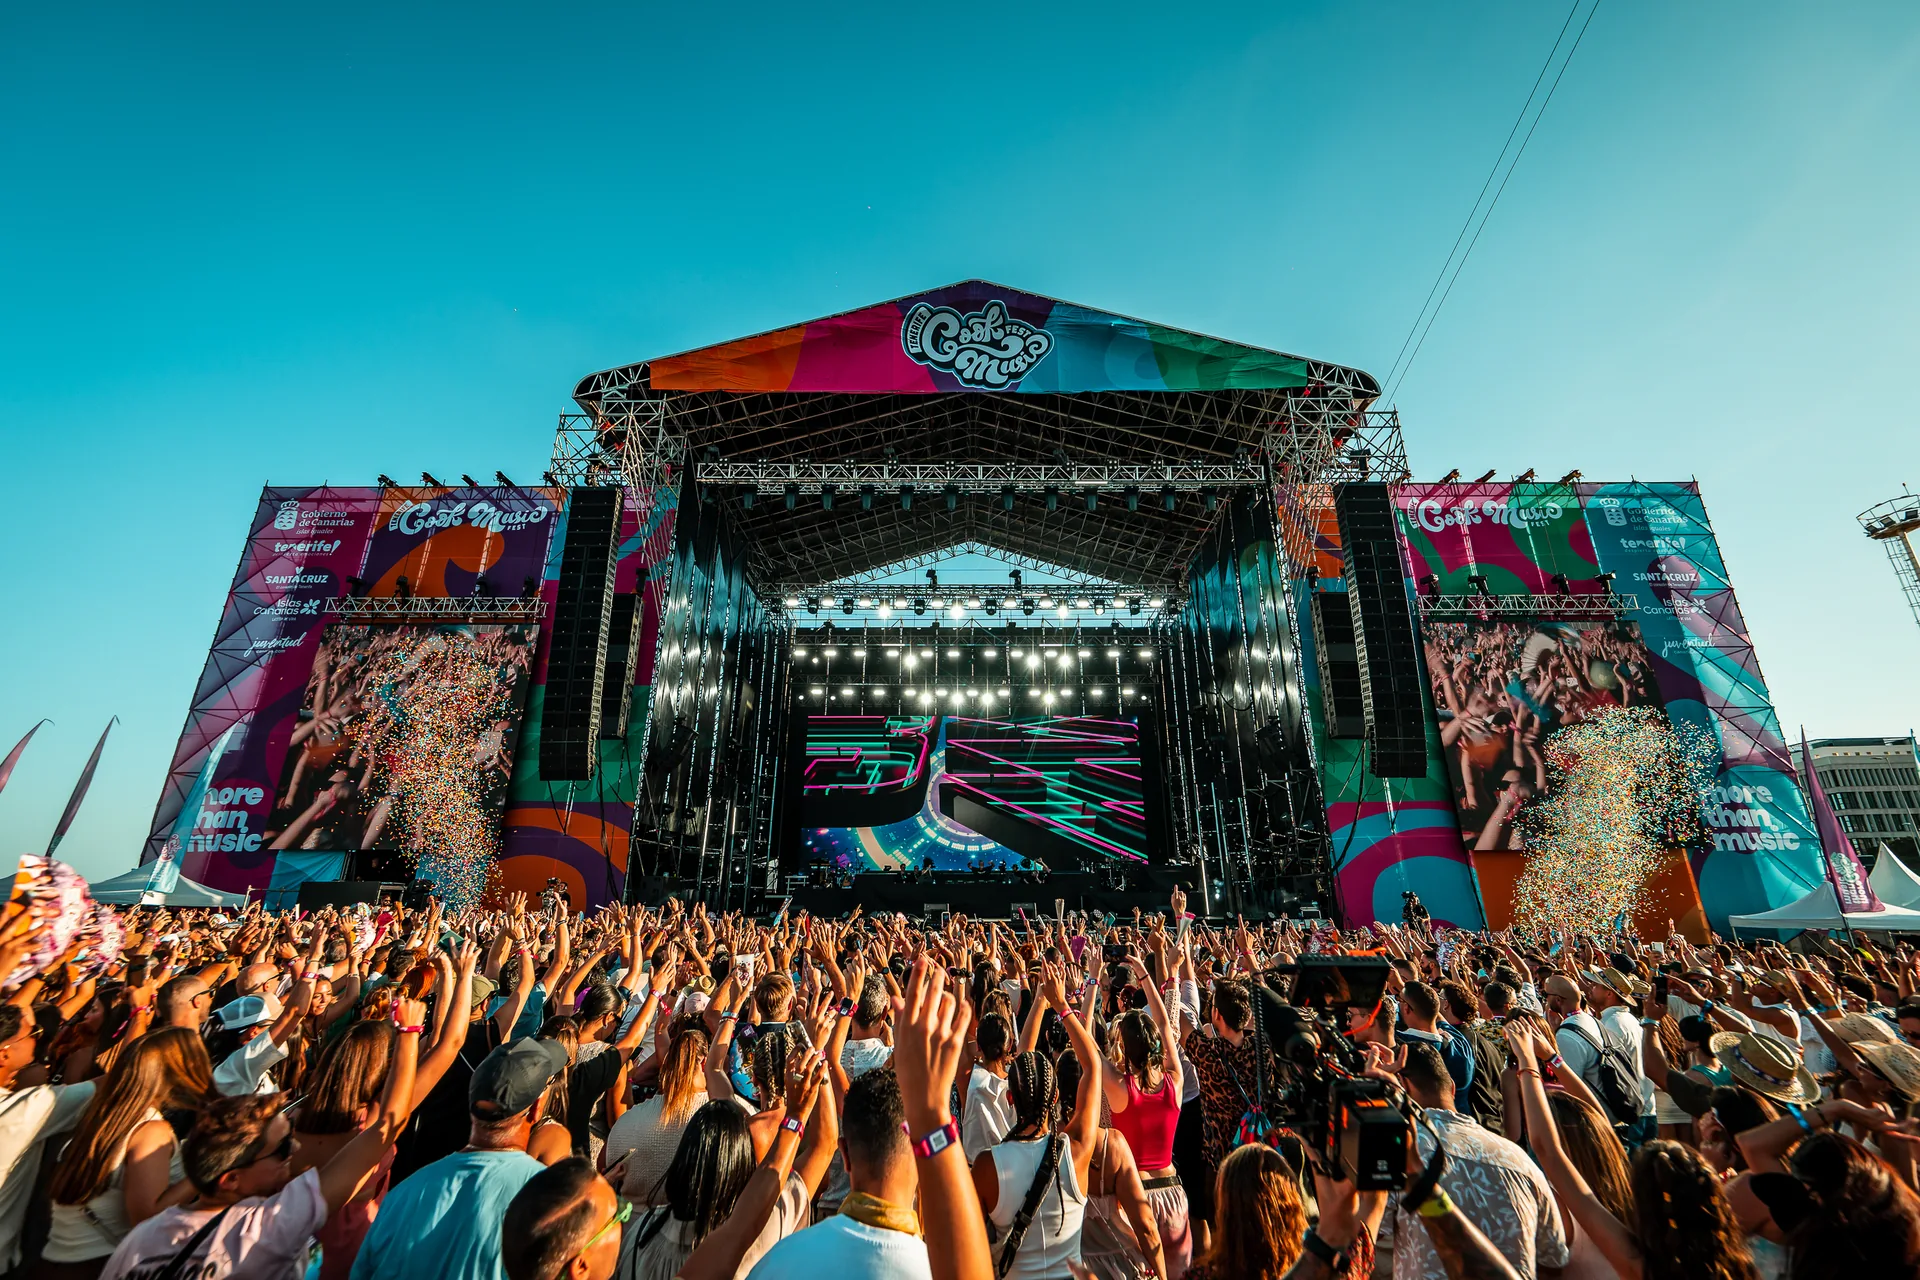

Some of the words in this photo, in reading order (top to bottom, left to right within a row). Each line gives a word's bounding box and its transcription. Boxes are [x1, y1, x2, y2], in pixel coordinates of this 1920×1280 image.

[909, 310, 928, 350] TENERIFE
[921, 305, 1006, 362] Cook
[1004, 324, 1031, 338] FEST
[954, 334, 1049, 385] Music
[301, 510, 347, 518] Gobierno
[399, 502, 467, 535] Cook
[467, 503, 548, 533] Music
[1418, 500, 1482, 532] Cook
[1482, 500, 1563, 529] Music
[1627, 507, 1675, 515] Gobierno
[1643, 515, 1689, 524] Canarias
[298, 519, 310, 527] de
[311, 518, 355, 526] Canarias
[507, 523, 526, 531] FEST
[1531, 520, 1550, 528] FEST
[253, 607, 300, 615] Canarias
[277, 599, 302, 607] Islas
[243, 631, 307, 658] juventud
[1662, 633, 1715, 658] juventud
[194, 806, 248, 829] han
[1712, 825, 1800, 851] music
